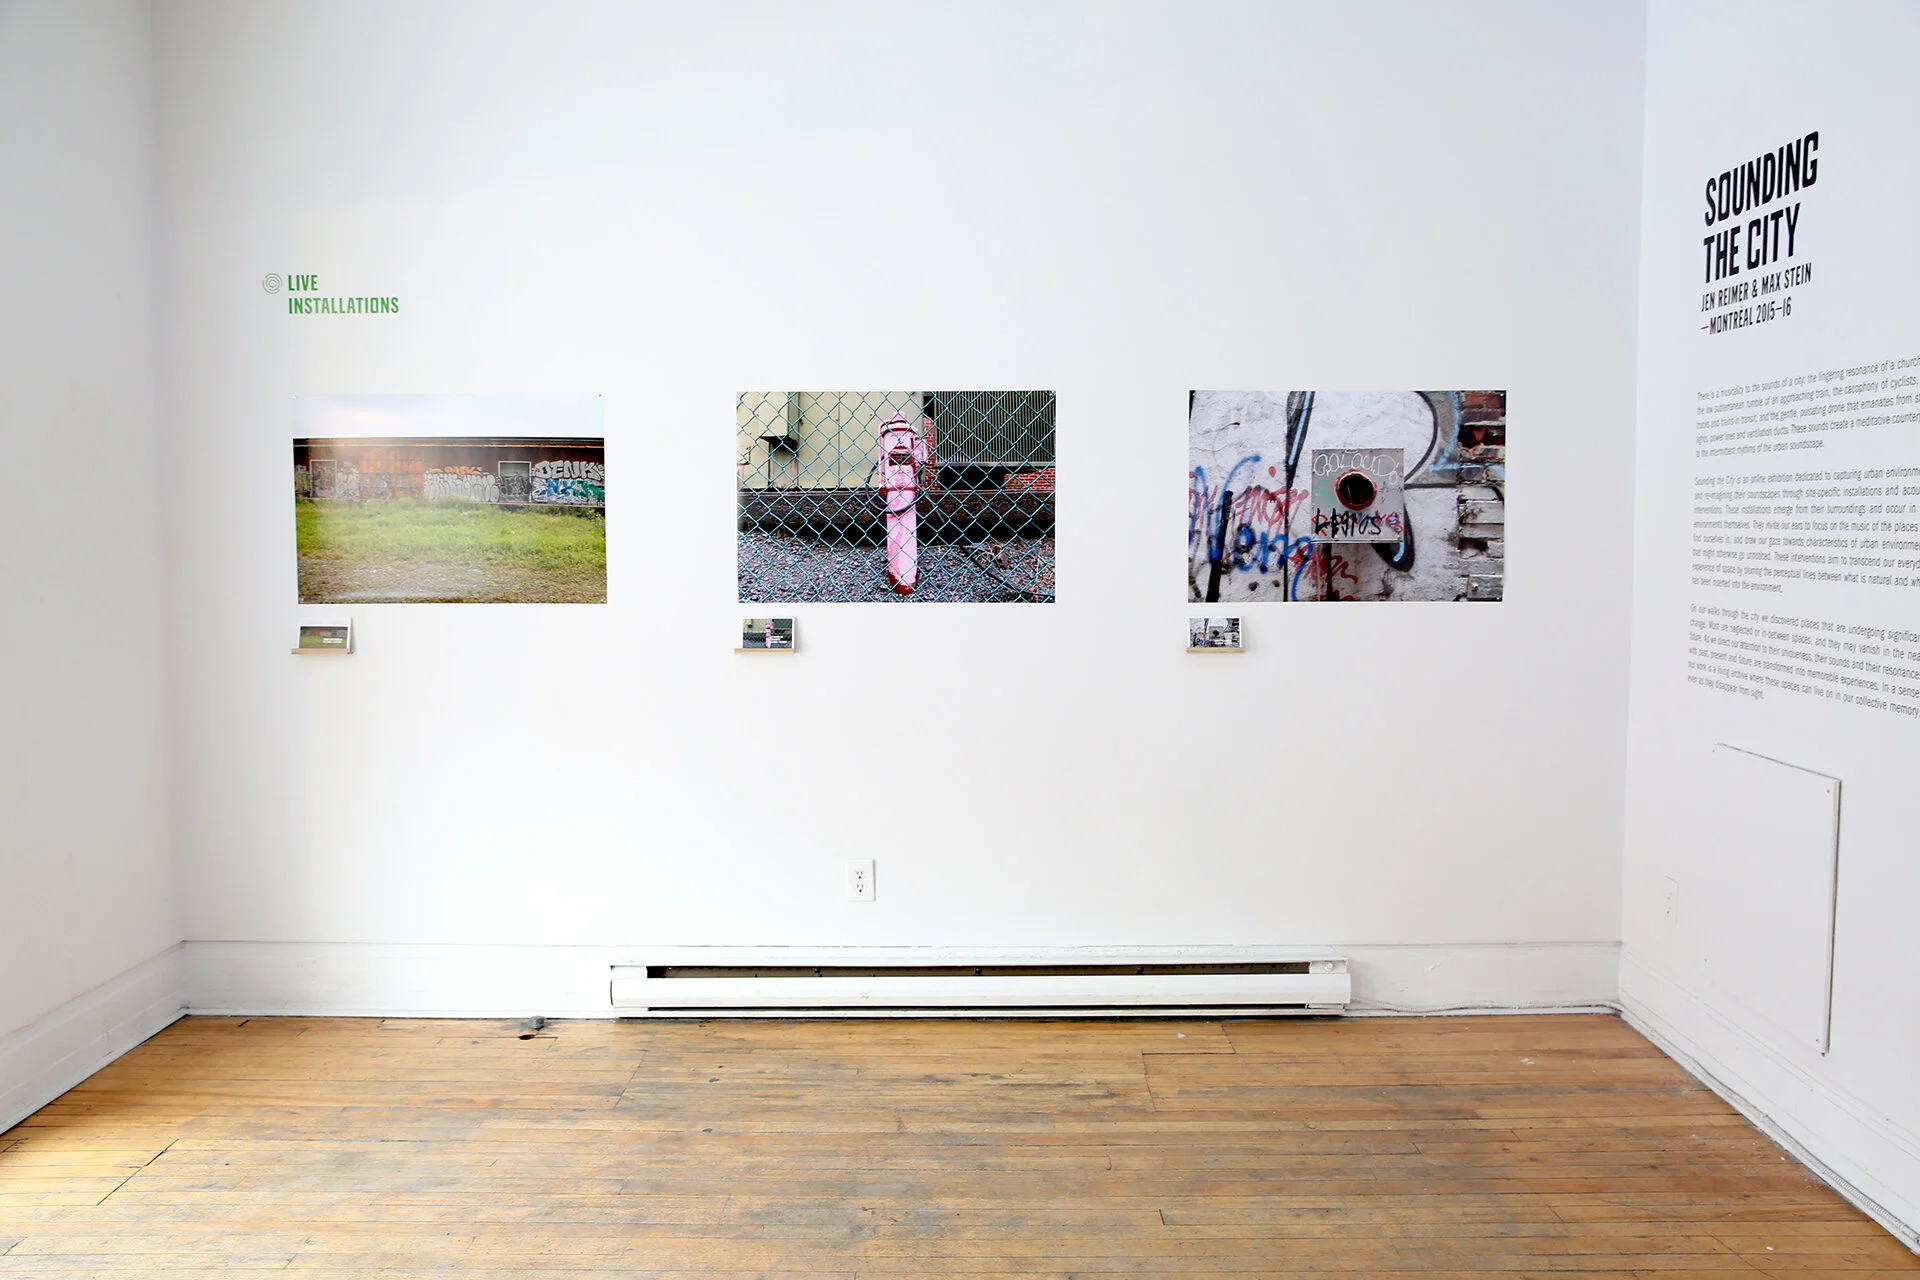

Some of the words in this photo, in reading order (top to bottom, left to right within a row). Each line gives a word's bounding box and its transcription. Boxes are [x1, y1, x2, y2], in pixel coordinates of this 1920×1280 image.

[1704, 131, 1819, 227] SOUNDING
[1703, 225, 1741, 284] THE
[1746, 202, 1801, 271] CITY
[288, 274, 319, 291] LIVE
[1701, 290, 1715, 312] JEN
[1717, 281, 1749, 307] REIMER
[1751, 279, 1758, 298] &
[1761, 271, 1781, 296] MAX
[1783, 262, 1813, 289] STEIN
[288, 297, 399, 314] INSTALLATIONS
[1846, 364, 1878, 376] resonance
[1880, 360, 1889, 371] of
[1889, 361, 1894, 370] a
[1844, 382, 1878, 394] cacophony
[1880, 377, 1888, 389] of
[1860, 397, 1893, 409] emanates
[1895, 394, 1911, 404] from
[1856, 415, 1890, 426] meditative
[1863, 469, 1883, 478] urban
[1885, 468, 1920, 477] environm
[1843, 486, 1881, 496] installations
[1885, 485, 1898, 495] and
[1902, 486, 1920, 495] acou
[1869, 504, 1882, 513] and
[1885, 505, 1906, 513] occur
[1909, 504, 1916, 512] in
[1851, 522, 1869, 531] music
[1871, 520, 1879, 531] of
[1880, 522, 1891, 531] the
[1894, 521, 1918, 533] places
[1859, 539, 1878, 548] urban
[1881, 540, 1920, 549] environme
[1849, 556, 1880, 566] transcend
[1883, 558, 1895, 567] our
[1860, 575, 1866, 583] is
[1868, 575, 1892, 585] natural
[1894, 576, 1908, 586] and
[1910, 576, 1920, 586] wh
[1848, 625, 1885, 640] undergoing
[1858, 645, 1880, 654] vanish
[1883, 648, 1890, 656] in
[1892, 648, 1904, 658] the
[1865, 662, 1881, 672] their
[1882, 666, 1920, 679] resonance
[1881, 681, 1889, 692] In
[1891, 685, 1896, 693] a
[1898, 686, 1920, 698] sense
[1855, 696, 1887, 709] collective
